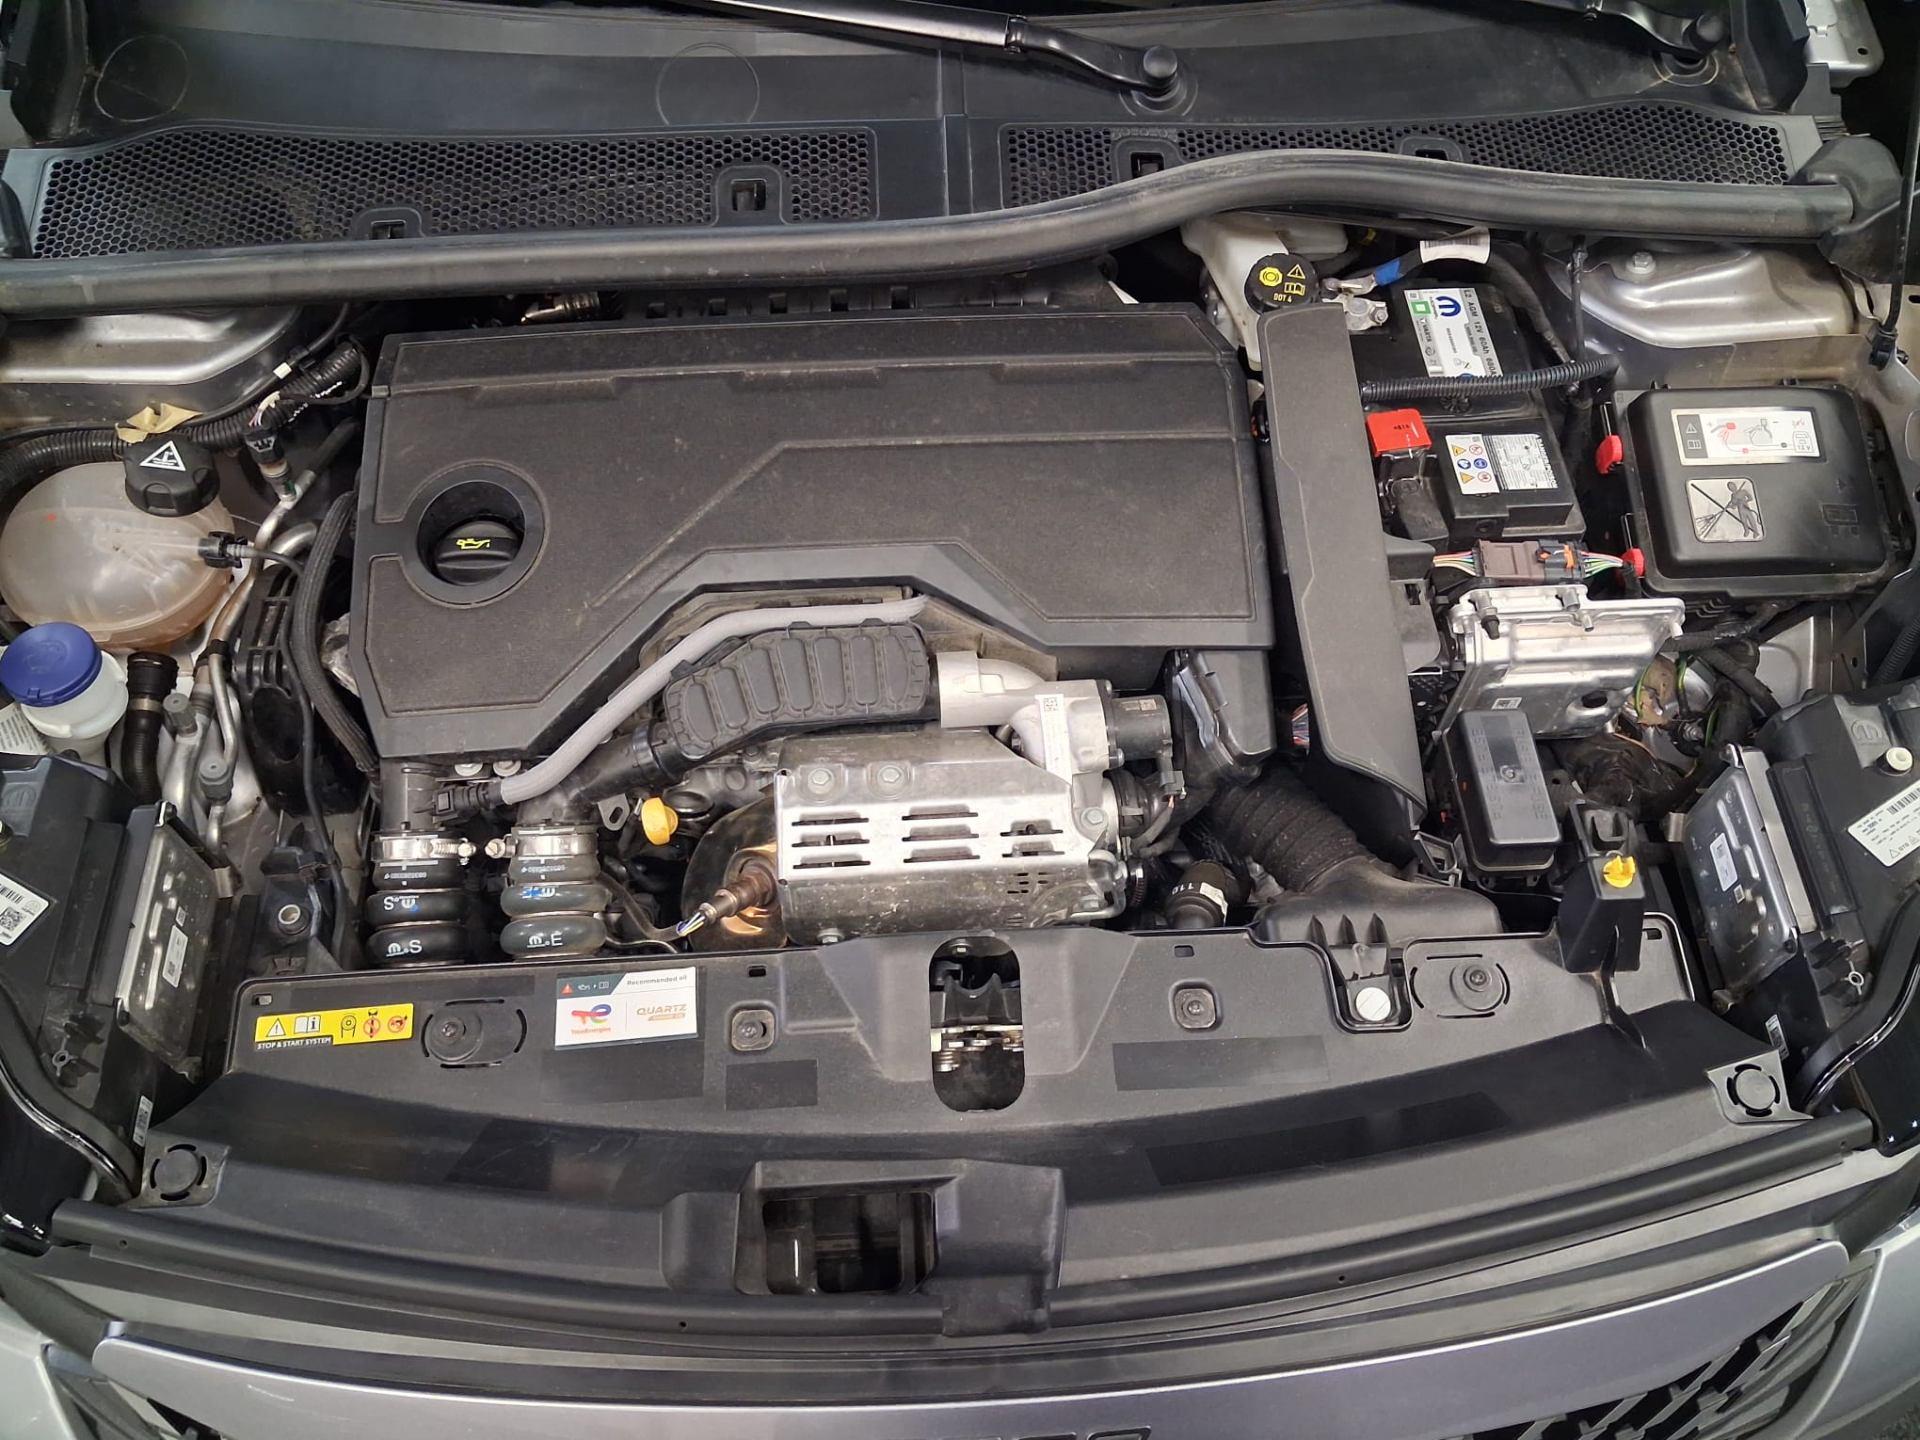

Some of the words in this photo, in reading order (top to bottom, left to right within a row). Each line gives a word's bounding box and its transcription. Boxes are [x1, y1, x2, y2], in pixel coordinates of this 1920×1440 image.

[1273, 293, 1287, 302] DOT
[1287, 295, 1293, 303] 4
[1463, 289, 1473, 298] L2
[1468, 301, 1479, 317] AGM
[1474, 321, 1484, 335] 12V
[1479, 337, 1490, 354] 60Ah
[1422, 324, 1433, 342] VARTA
[627, 976, 678, 985] Recommended
[636, 1003, 688, 1016] QUARTZ
[283, 1040, 304, 1048] START
[305, 1037, 331, 1046] SYSTEM
